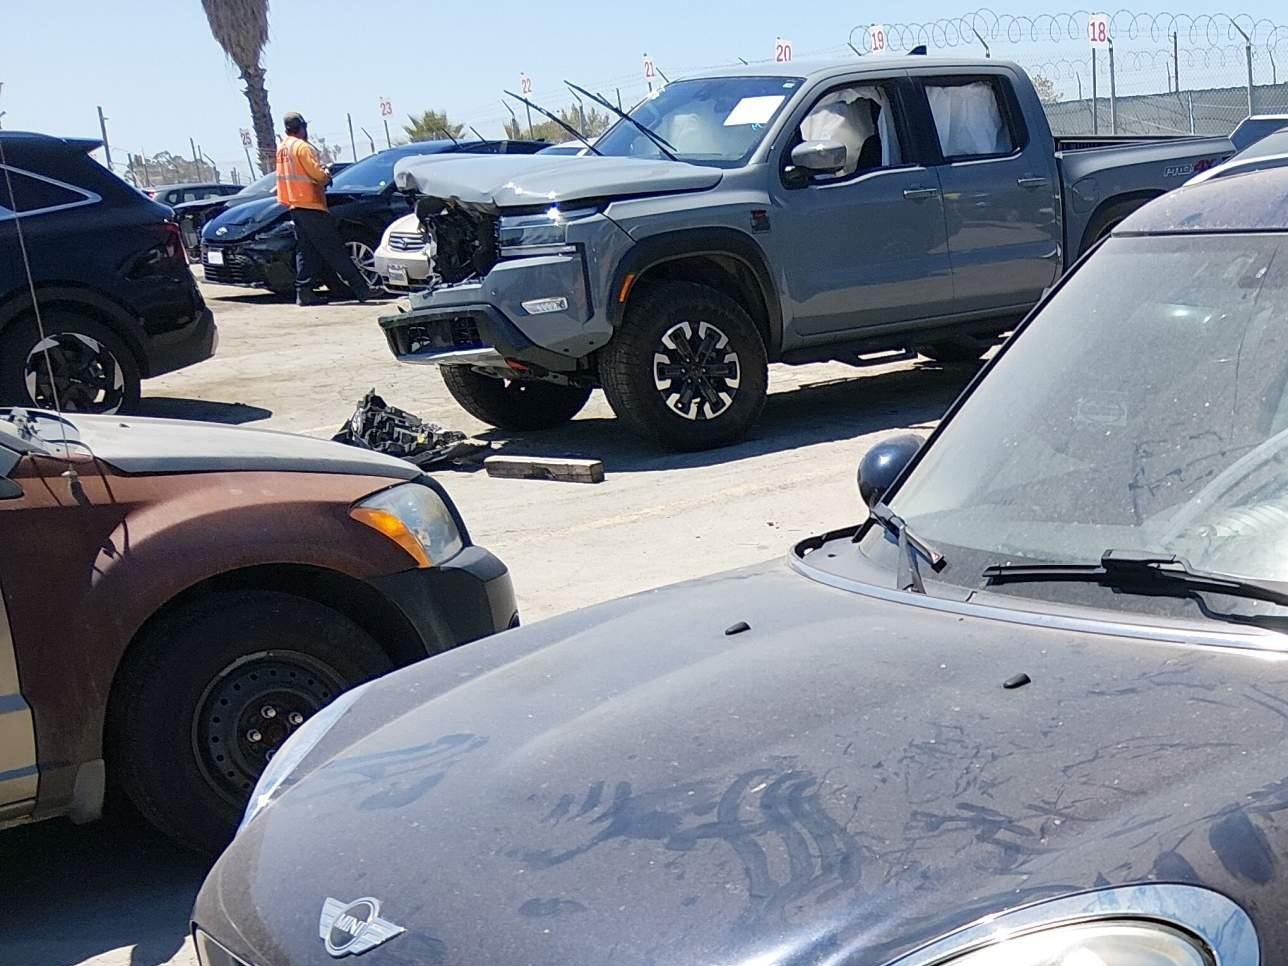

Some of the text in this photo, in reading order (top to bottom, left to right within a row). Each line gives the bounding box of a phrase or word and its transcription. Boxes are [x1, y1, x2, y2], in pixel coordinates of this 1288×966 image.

[1090, 21, 1106, 42] 18
[871, 30, 885, 51] 19
[776, 44, 792, 62] 20
[644, 61, 655, 78] 21
[521, 78, 533, 94] 22
[379, 101, 393, 117] 23
